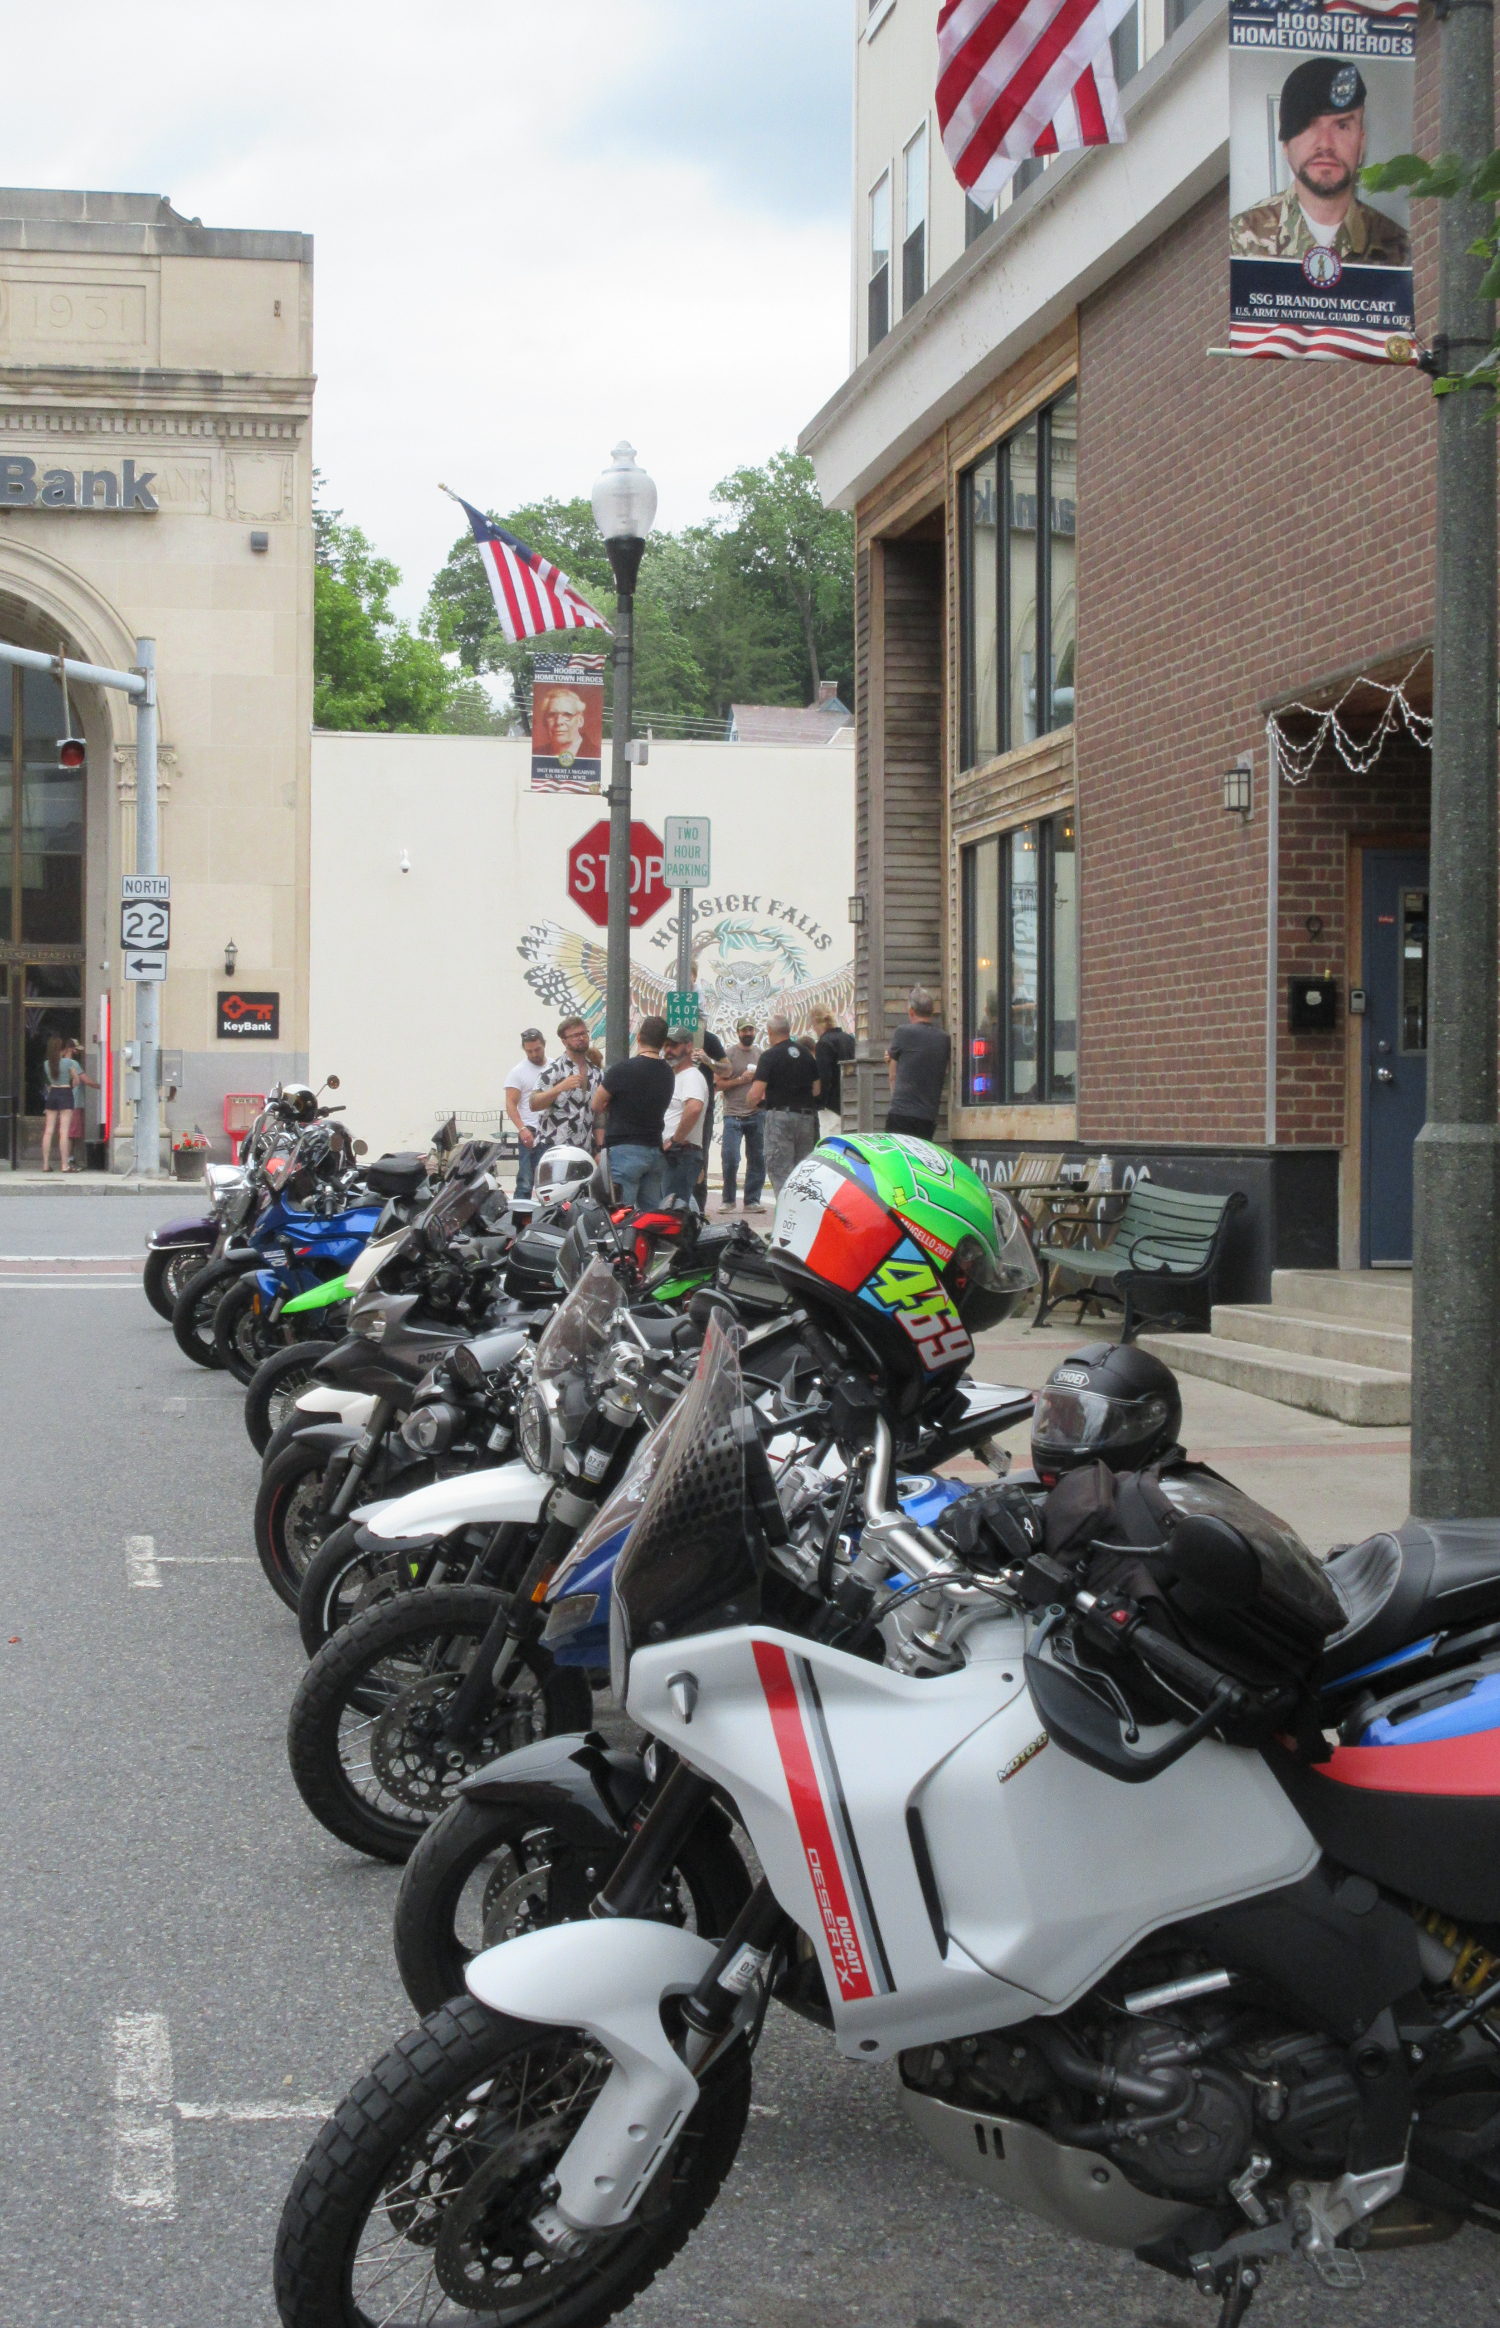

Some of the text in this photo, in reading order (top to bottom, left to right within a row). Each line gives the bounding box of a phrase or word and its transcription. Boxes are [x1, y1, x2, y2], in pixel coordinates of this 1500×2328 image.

[1276, 12, 1369, 34] HOOSICK
[1232, 26, 1413, 55] HOMETOWN HEROES
[33, 294, 126, 331] 1931
[1249, 293, 1396, 313] SSG BRANDON MCCART
[1235, 306, 1251, 317] U.S.
[1252, 307, 1280, 318] ARMY
[1280, 309, 1327, 321] NATIONAL
[1328, 311, 1360, 323] GUARD
[1365, 314, 1382, 324] OIF
[1382, 315, 1390, 325] &
[0, 455, 159, 509] Bank
[534, 673, 604, 683] HOMETOWN HEROES
[554, 667, 585, 675] HOOSICK
[677, 827, 699, 841] TWO
[673, 845, 701, 859] HOUR
[666, 863, 709, 877] PARKING
[125, 880, 167, 894] NORTH
[126, 912, 165, 938] 22
[767, 898, 833, 951] FALLS
[669, 1005, 698, 1016] 1407
[223, 1021, 272, 1033] KeyBank
[783, 1220, 797, 1231] DOT
[899, 1217, 954, 1259] MUGELLO 2017
[1056, 1371, 1086, 1386] SHOEI
[807, 1848, 855, 1988] DESERTX
[836, 1915, 863, 1974] DUCATI
